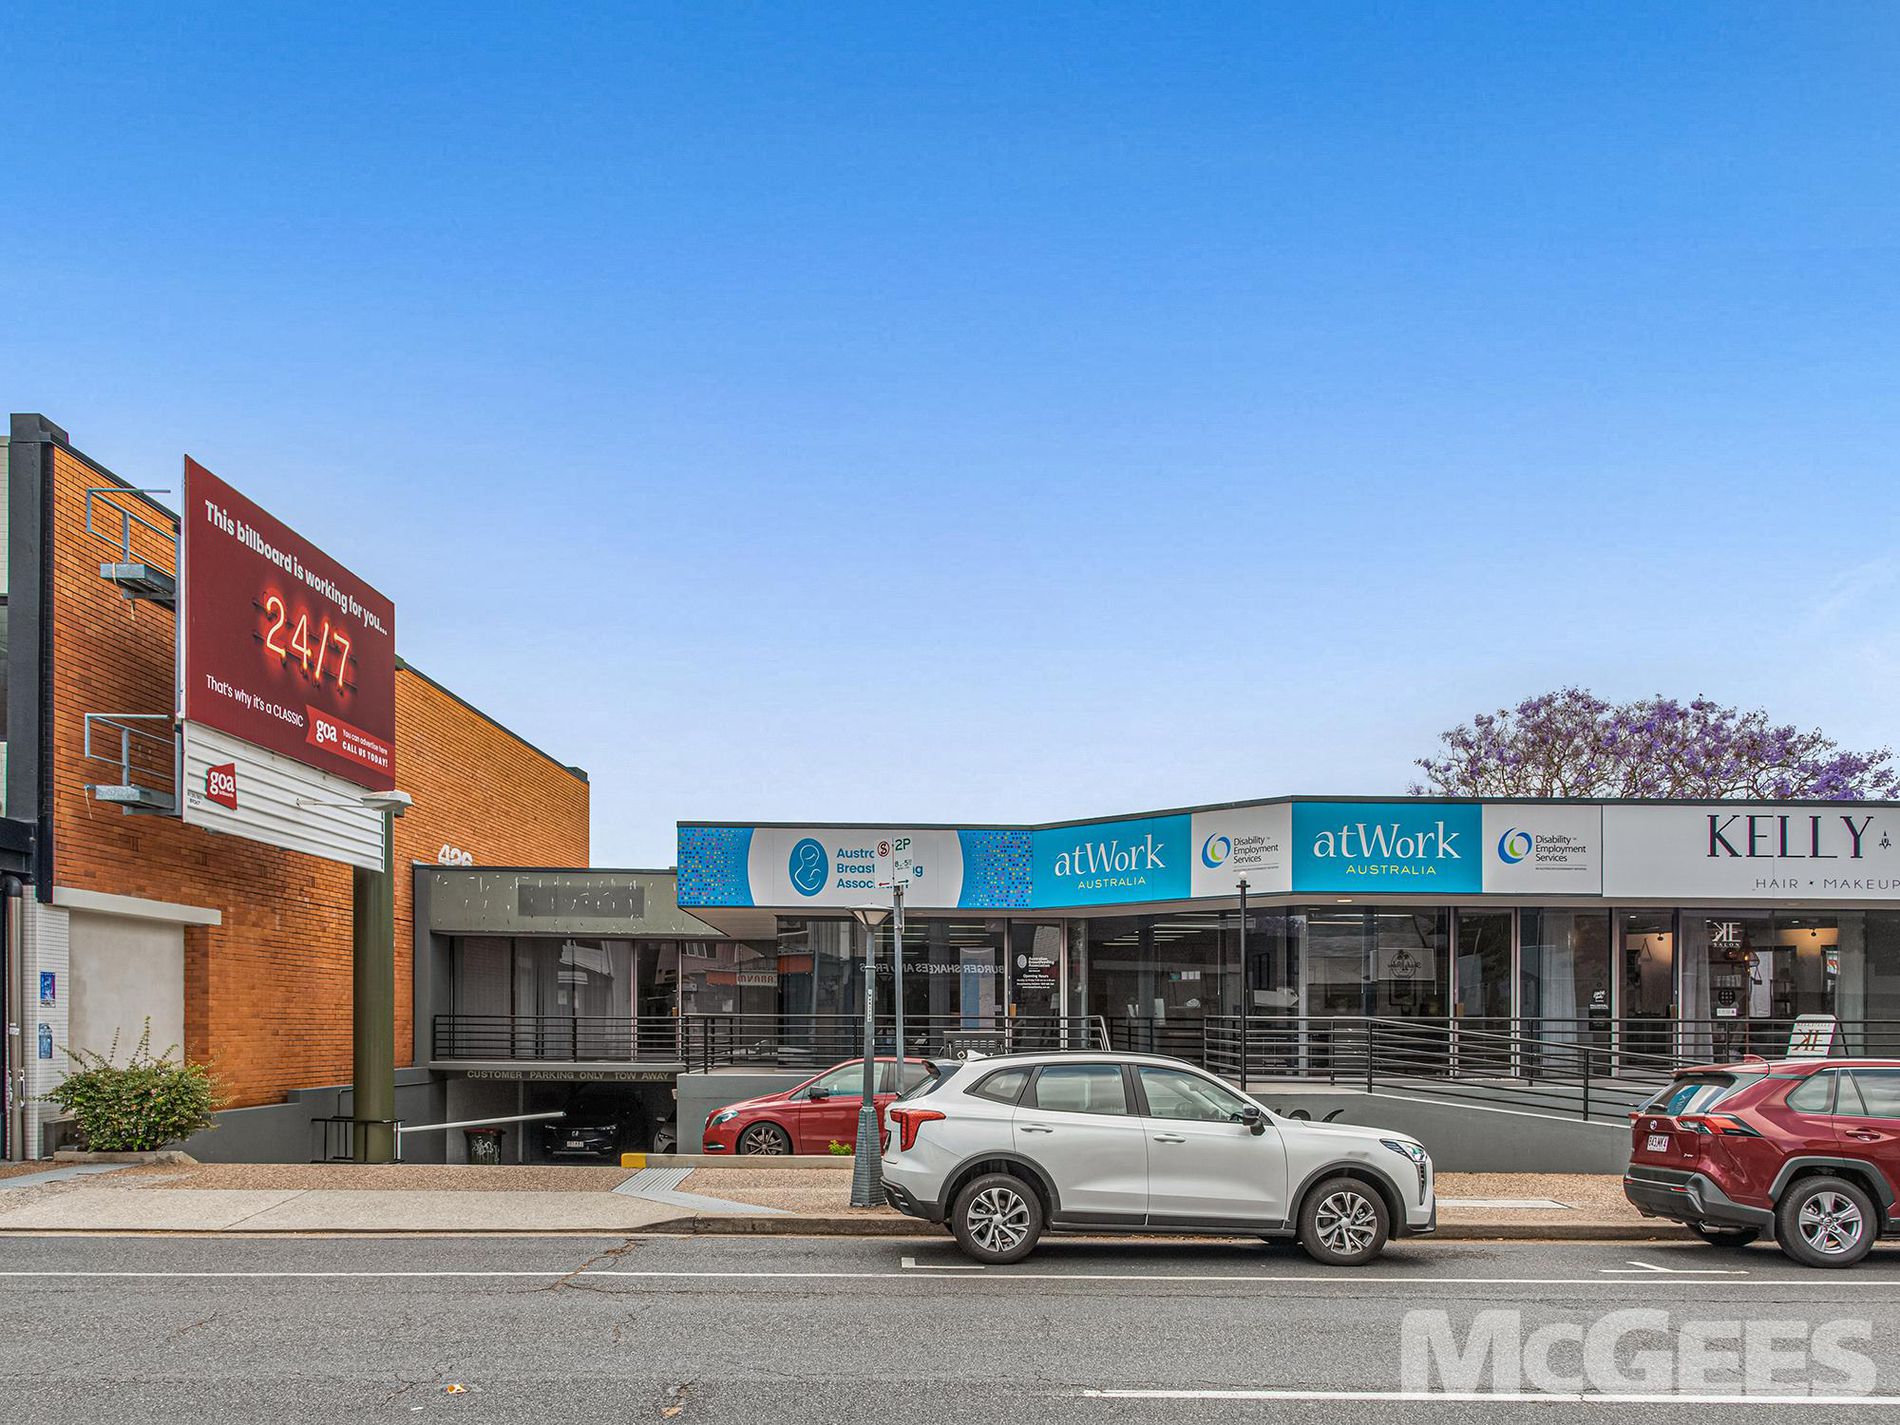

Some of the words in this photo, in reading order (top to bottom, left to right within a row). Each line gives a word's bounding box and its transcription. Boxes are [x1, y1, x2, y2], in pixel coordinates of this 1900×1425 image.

[205, 499, 235, 536] This
[237, 520, 292, 573] billboard
[294, 556, 304, 581] is
[305, 569, 348, 614] working
[349, 595, 363, 618] for
[266, 596, 350, 687] 24/7
[206, 674, 233, 698] That's
[234, 688, 252, 710] why
[253, 694, 265, 712] it's
[266, 703, 272, 714] a
[273, 704, 304, 728] CLASSIC
[316, 719, 338, 743] goa
[342, 740, 358, 754] CALL
[358, 748, 367, 758] US
[367, 751, 388, 768] TODAY!
[210, 771, 235, 795] goa
[1233, 835, 1266, 846] Disability
[1313, 820, 1462, 859] atWork
[1536, 835, 1571, 846] Disability
[1707, 814, 1874, 859] KELLY
[895, 838, 911, 851] 2P
[1233, 844, 1279, 856] Employment
[1536, 844, 1586, 855] Employment
[1054, 833, 1166, 877] atWork
[1233, 855, 1262, 864] Services
[1536, 853, 1568, 862] Services
[1346, 864, 1437, 875] AUSTRALIA
[1078, 876, 1147, 889] AUSTRALIA
[1756, 879, 1799, 889] HAIR
[1823, 879, 1900, 890] MAKEUP
[467, 1071, 522, 1079] CUSTOMER
[530, 1071, 574, 1079] PARKING
[579, 1071, 604, 1080] ONLY
[615, 1072, 636, 1080] TOW
[641, 1072, 669, 1080] AWAY
